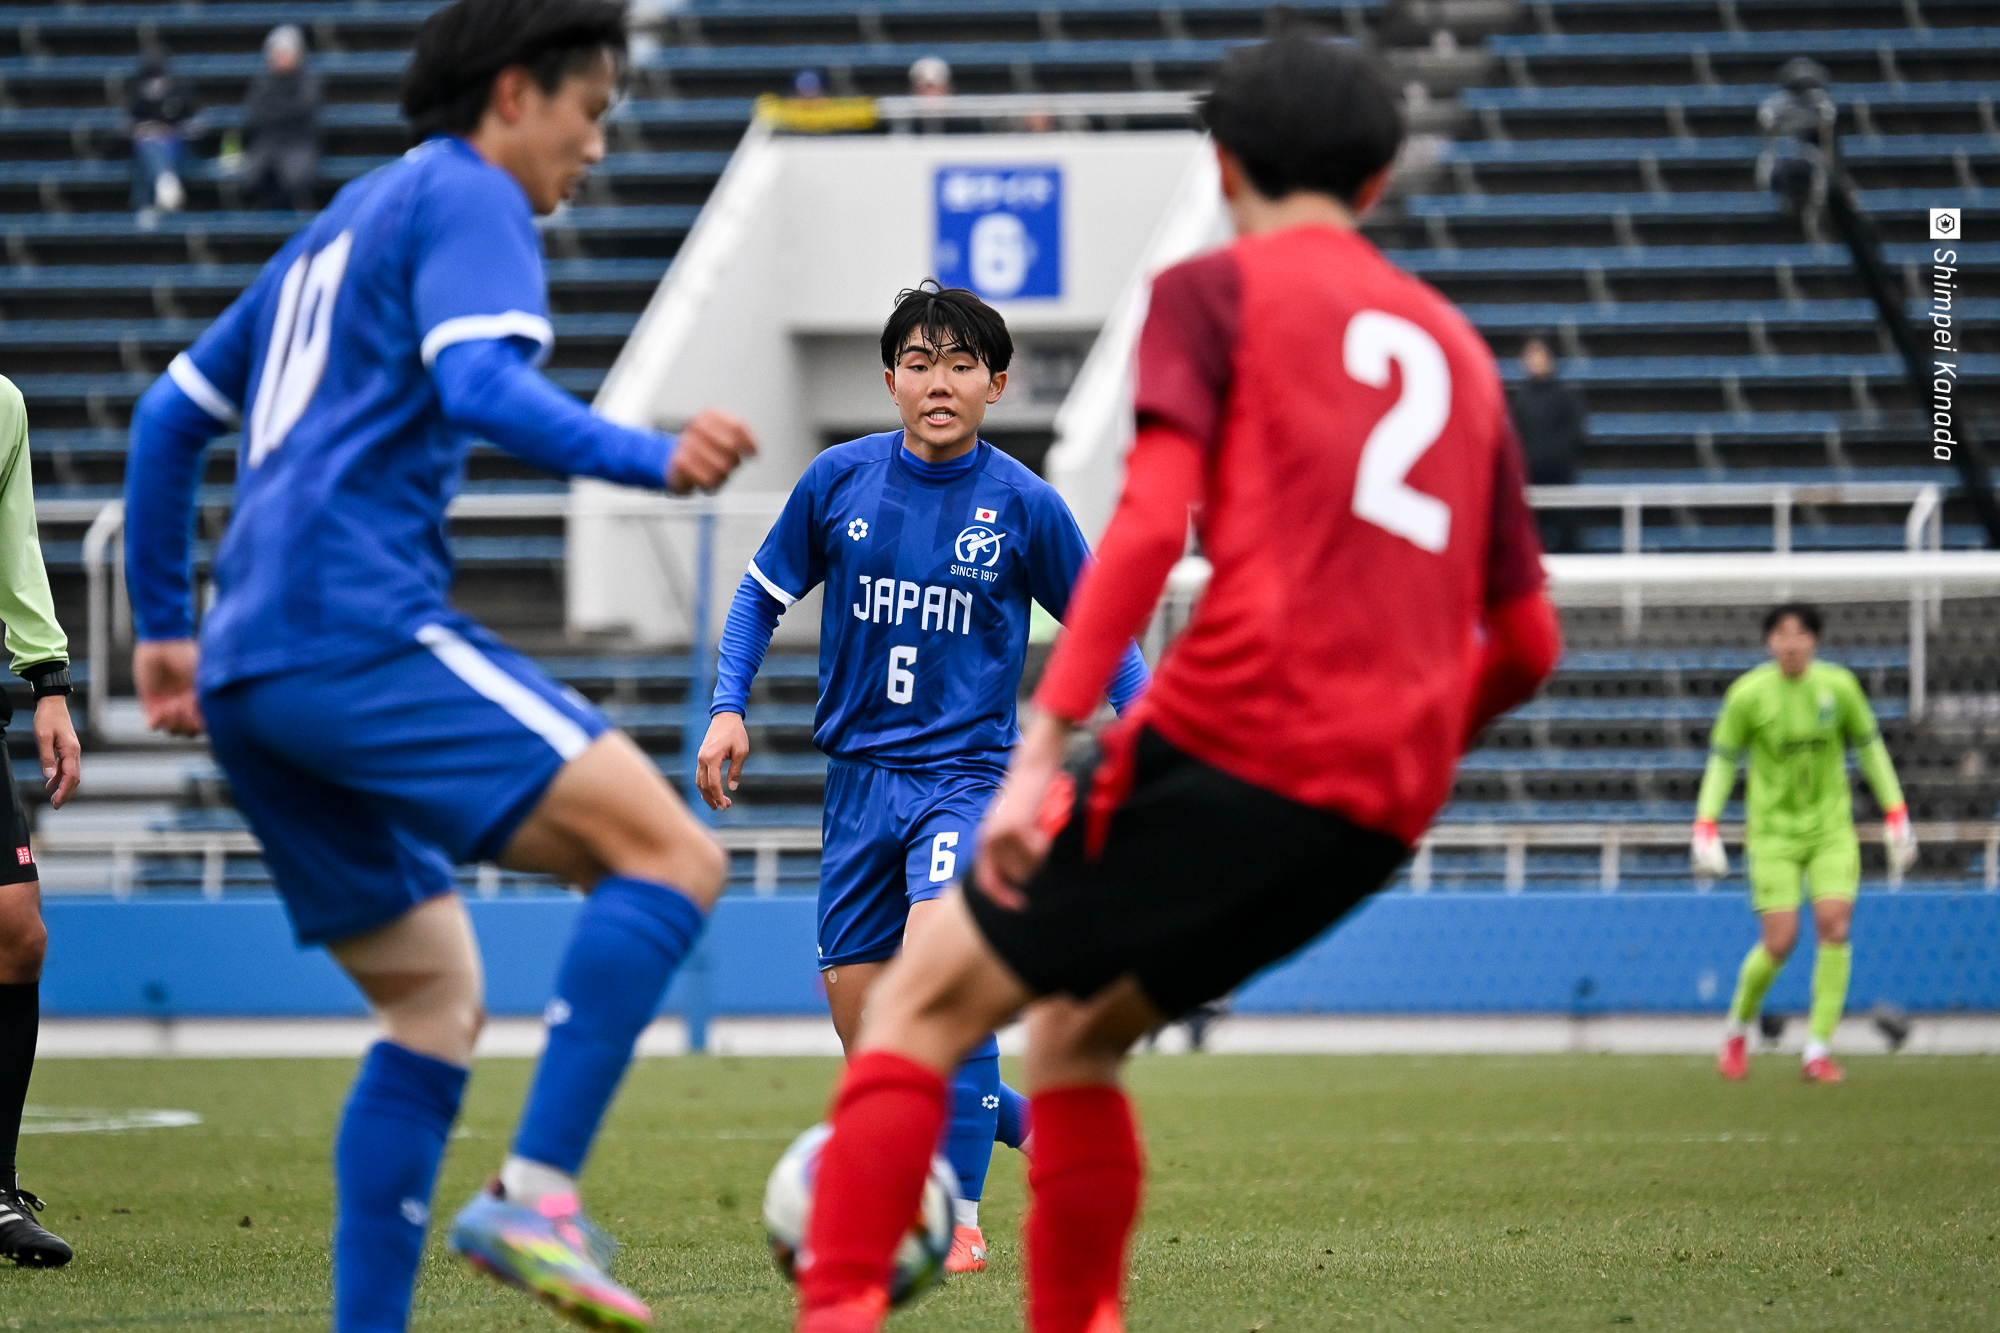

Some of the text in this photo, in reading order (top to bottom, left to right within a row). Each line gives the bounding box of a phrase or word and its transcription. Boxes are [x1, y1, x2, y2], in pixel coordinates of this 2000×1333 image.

[1342, 309, 1452, 554] 2
[950, 564, 999, 583] SINCE 1917
[852, 574, 974, 636] JAPAN
[886, 644, 918, 705] 6
[928, 831, 959, 883] 6
